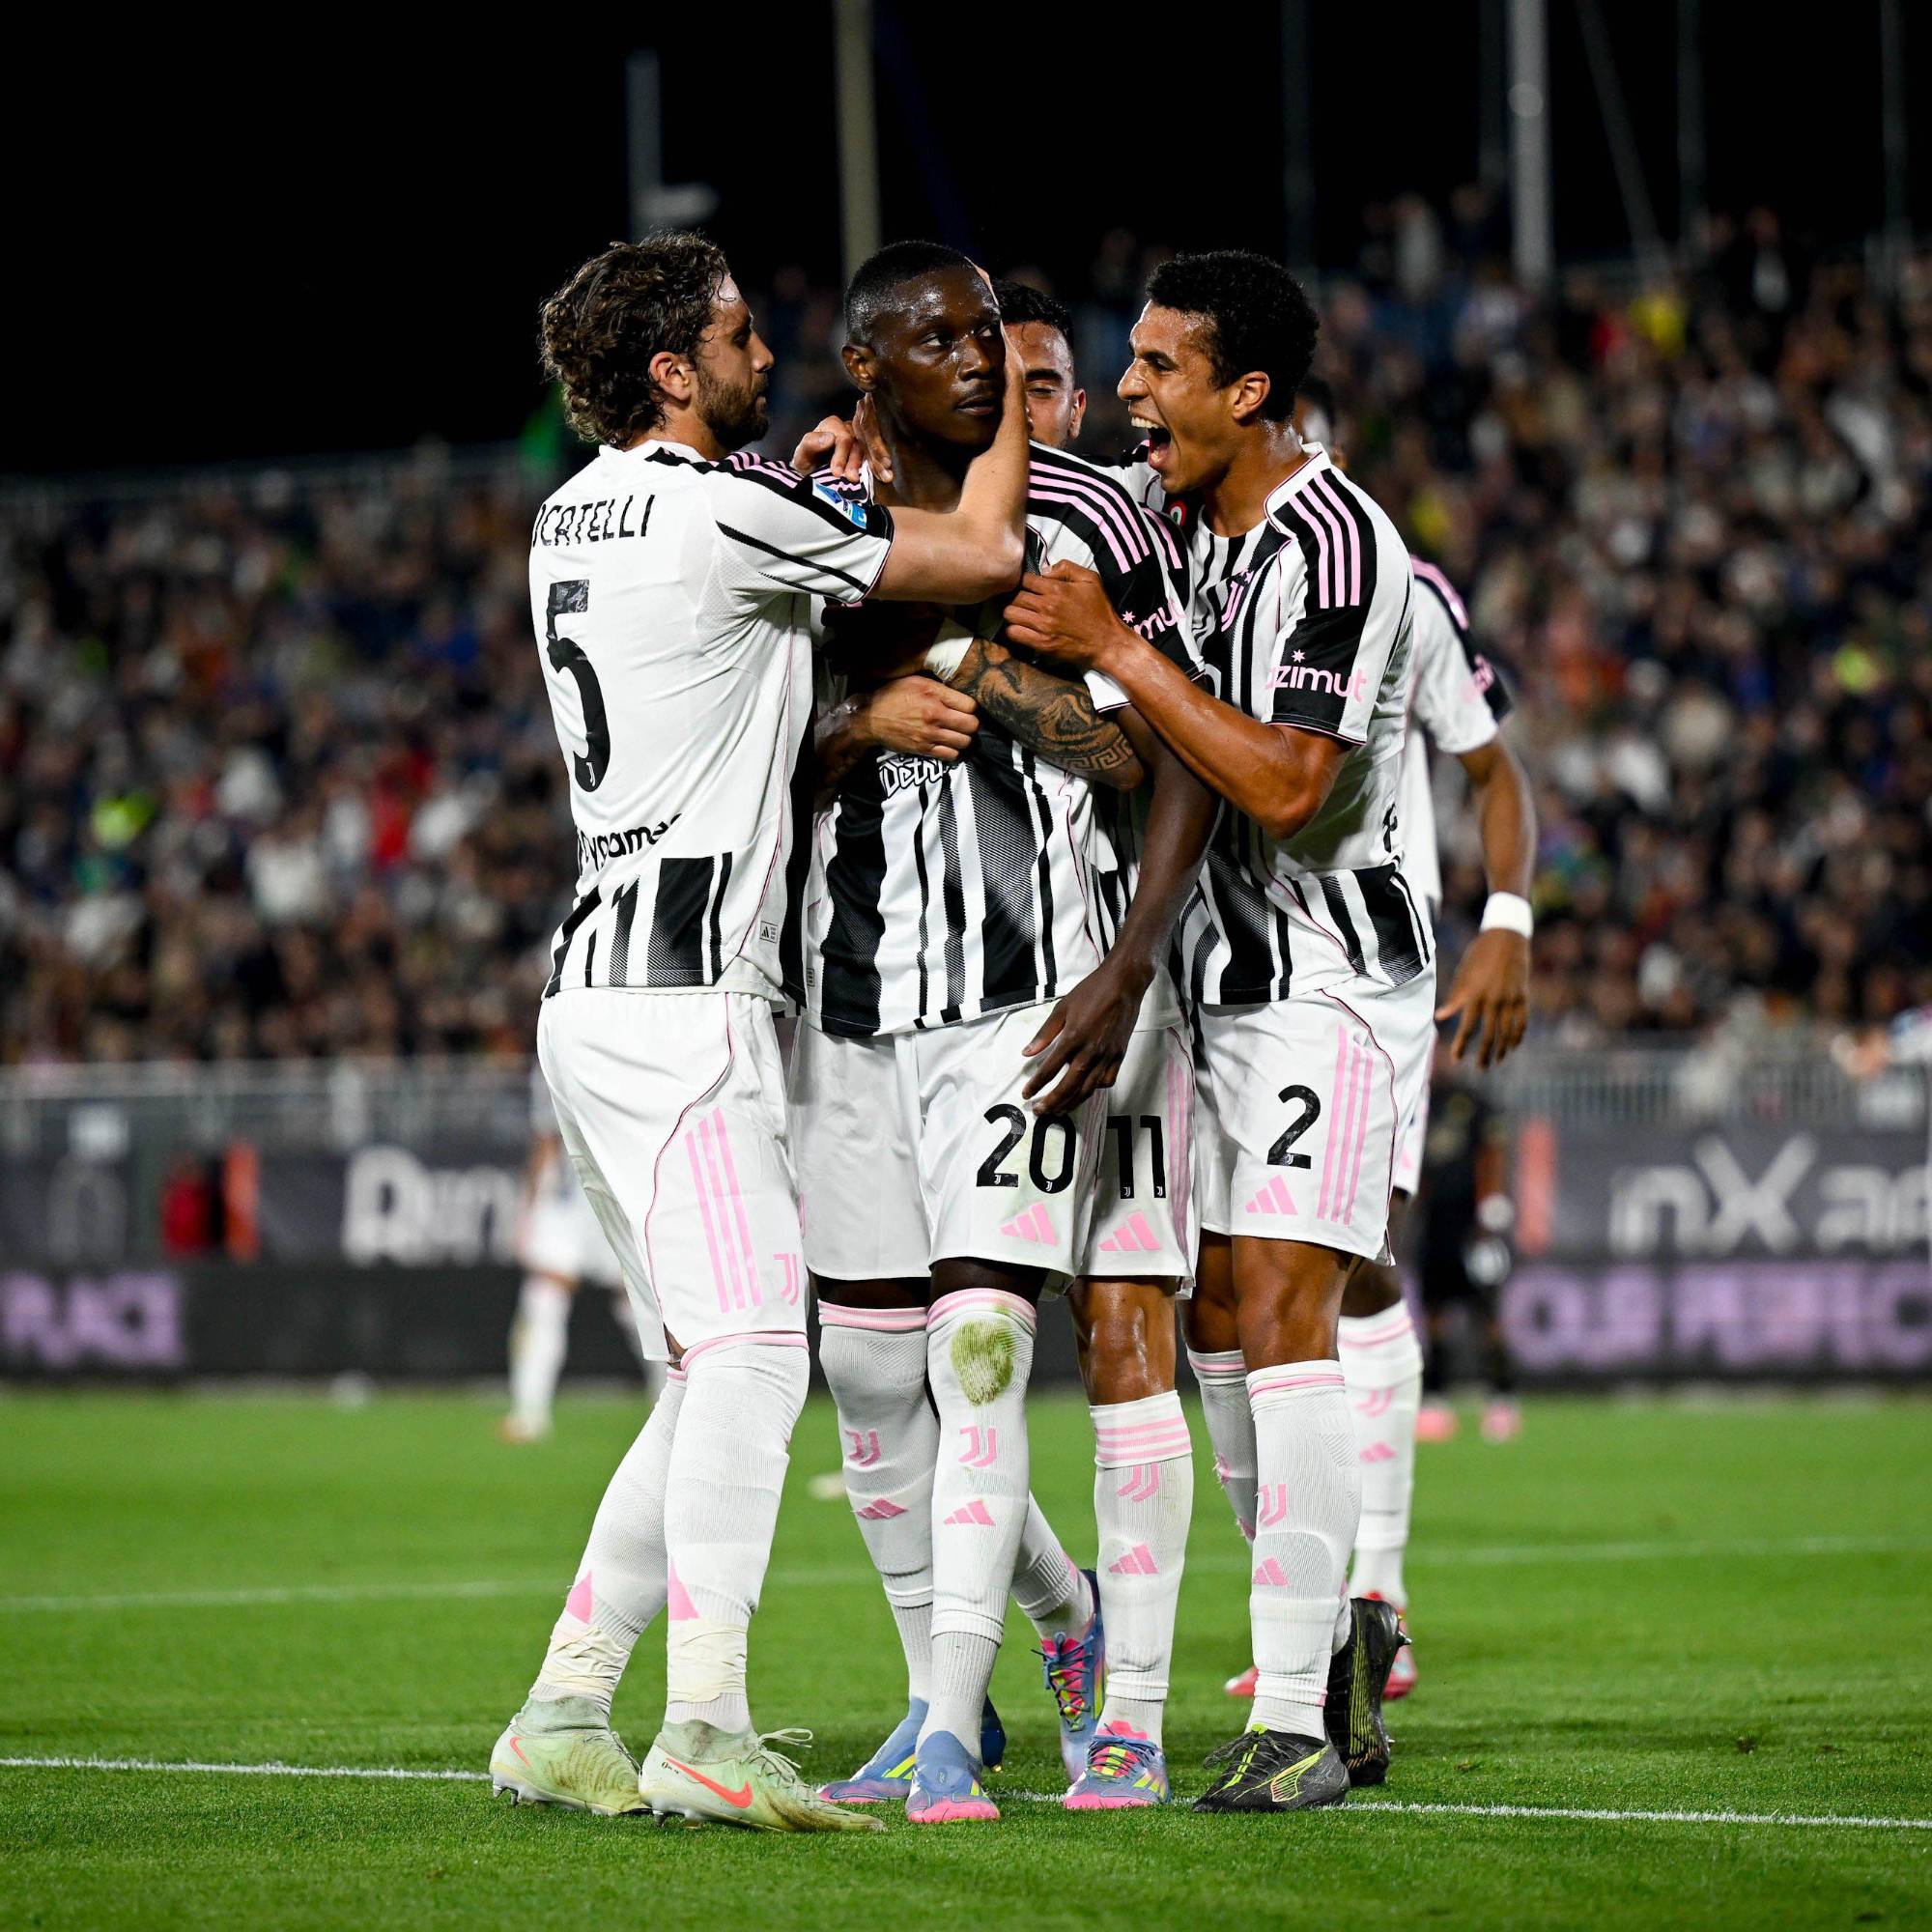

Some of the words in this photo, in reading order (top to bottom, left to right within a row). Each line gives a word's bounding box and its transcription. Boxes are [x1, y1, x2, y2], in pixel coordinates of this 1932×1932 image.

[546, 579, 611, 792] 5
[976, 1103, 1077, 1195] 20
[1106, 1114, 1167, 1200] 11
[1266, 1084, 1321, 1170] 2
